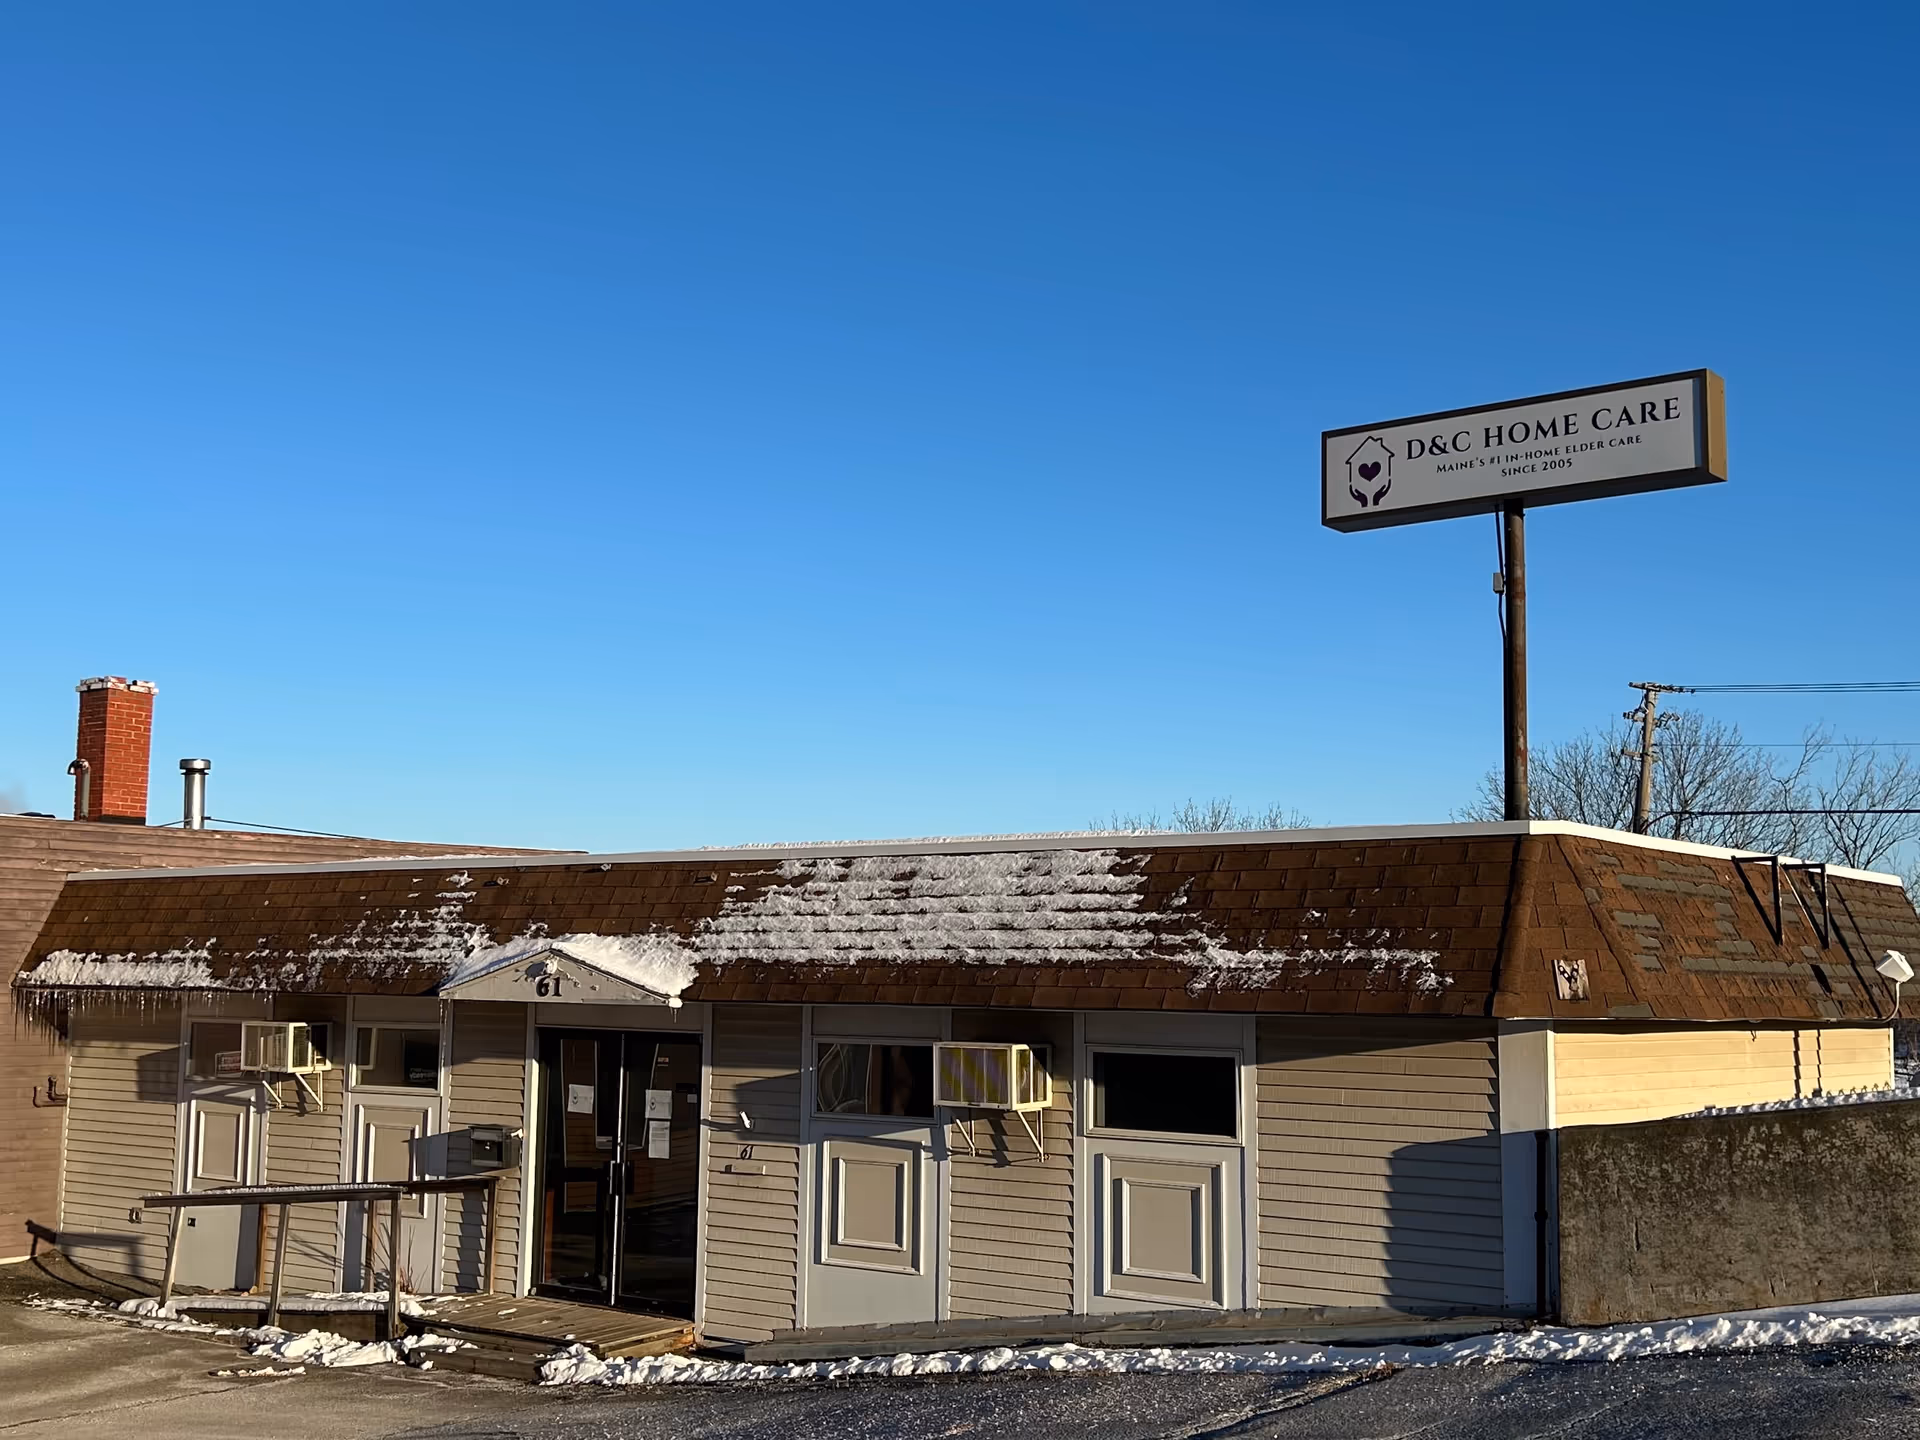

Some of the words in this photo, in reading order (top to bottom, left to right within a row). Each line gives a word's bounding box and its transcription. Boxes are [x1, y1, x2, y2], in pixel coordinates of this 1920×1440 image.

[1406, 430, 1472, 461] D&C
[1483, 413, 1580, 449] HOME
[1591, 397, 1681, 431] CARE
[1436, 456, 1486, 474] MAINE'S
[1489, 455, 1501, 465] #1
[1505, 446, 1561, 463] IN-HOME
[1565, 440, 1605, 454] ELDER
[1608, 434, 1643, 448] CARE
[1501, 463, 1538, 477] SINCE
[1541, 457, 1573, 471] 2005
[535, 975, 563, 998] 61
[740, 1144, 754, 1160] 61
